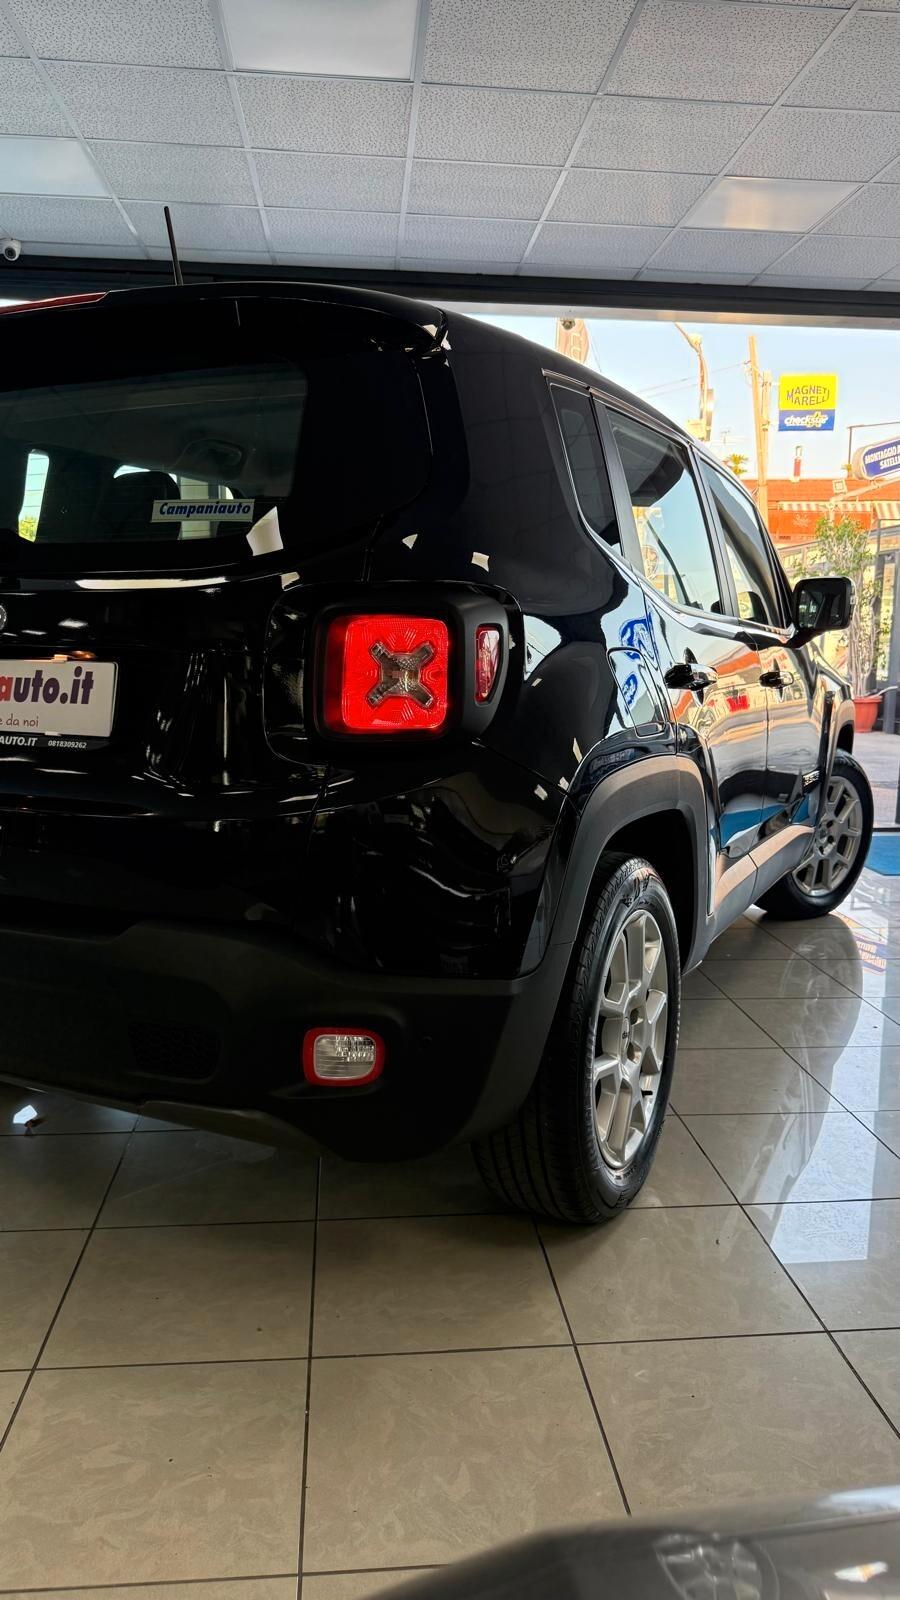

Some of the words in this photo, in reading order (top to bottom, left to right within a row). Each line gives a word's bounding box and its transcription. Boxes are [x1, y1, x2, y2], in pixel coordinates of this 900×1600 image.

[159, 501, 251, 518] Campaniauto
[6, 713, 20, 727] da
[23, 716, 39, 727] noi
[48, 739, 87, 749] 0818309262
